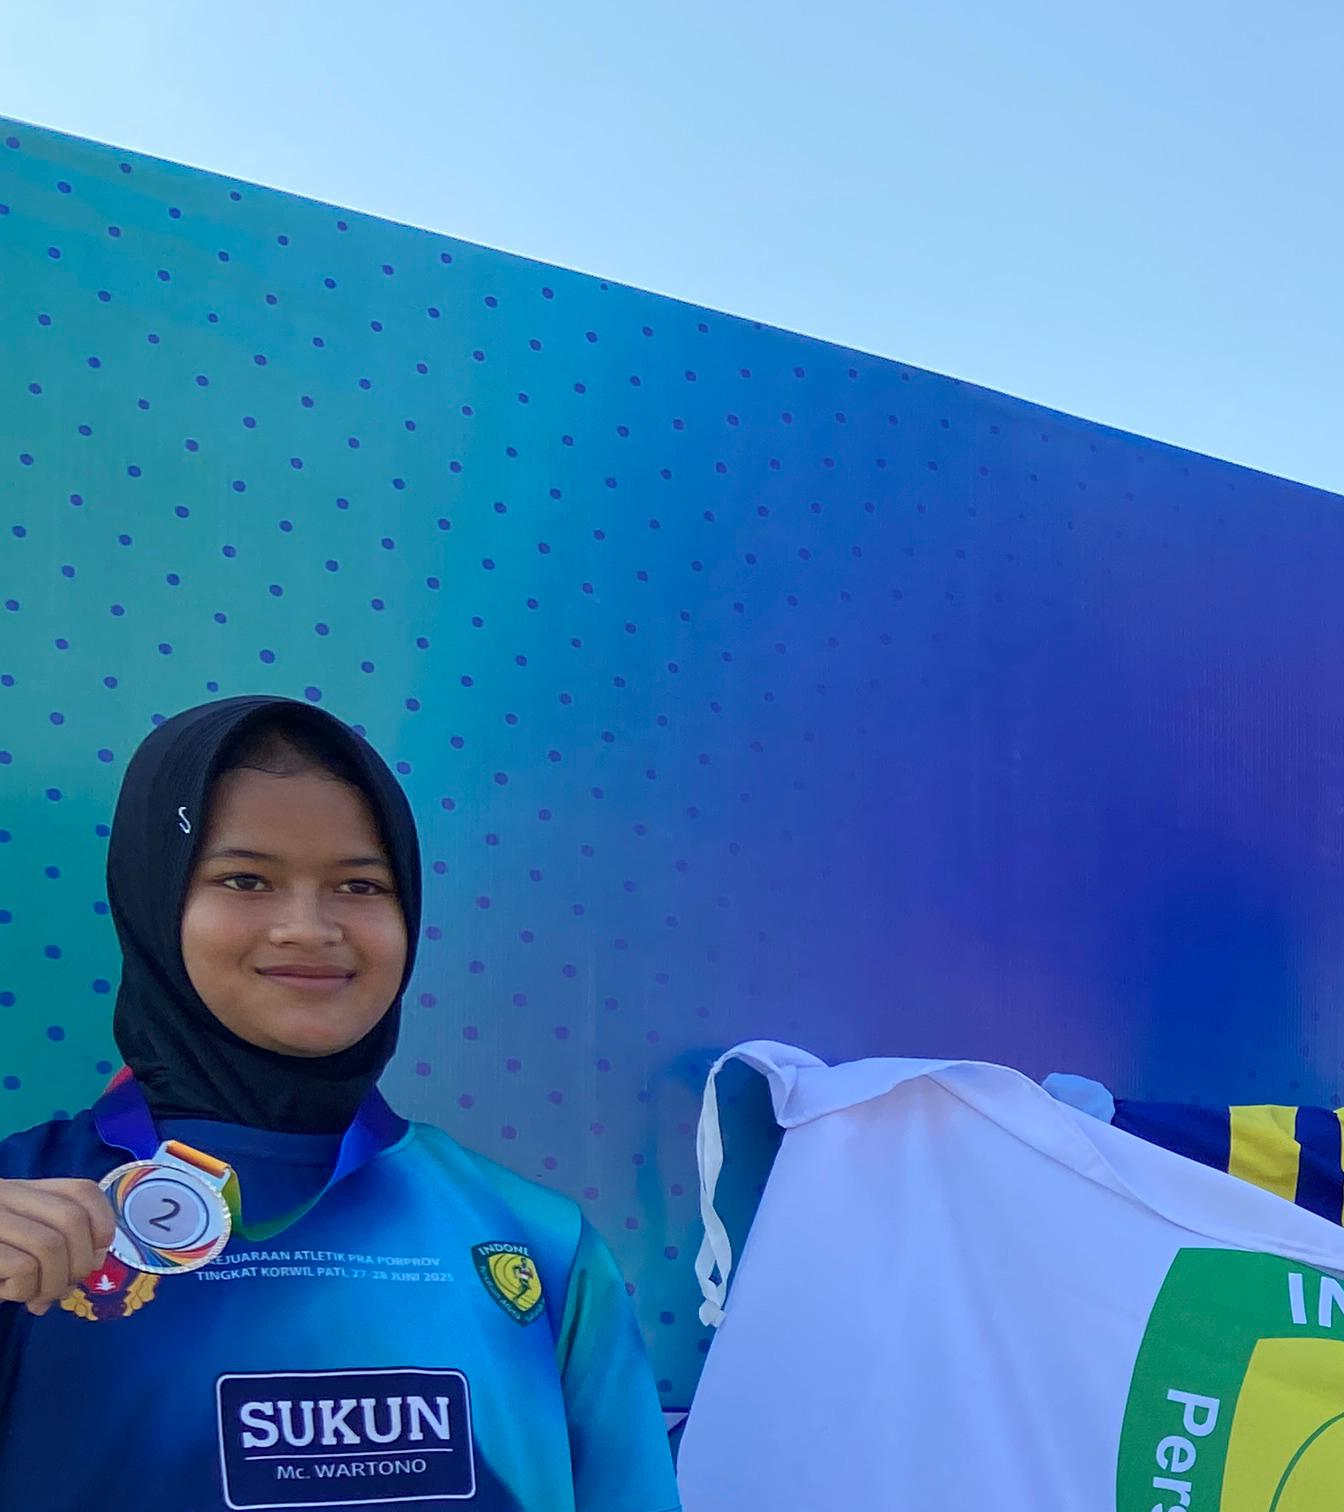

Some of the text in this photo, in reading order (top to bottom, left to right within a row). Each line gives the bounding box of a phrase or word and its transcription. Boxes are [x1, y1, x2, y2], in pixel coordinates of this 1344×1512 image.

[148, 1199, 180, 1232] 2
[294, 1250, 344, 1262] ATLETIK
[348, 1254, 374, 1265] PRA
[197, 1267, 257, 1281] TINGKAT
[261, 1266, 315, 1277] KORWIL
[240, 1395, 450, 1448] SUKUN
[276, 1458, 427, 1480] Mc. WARTONO
